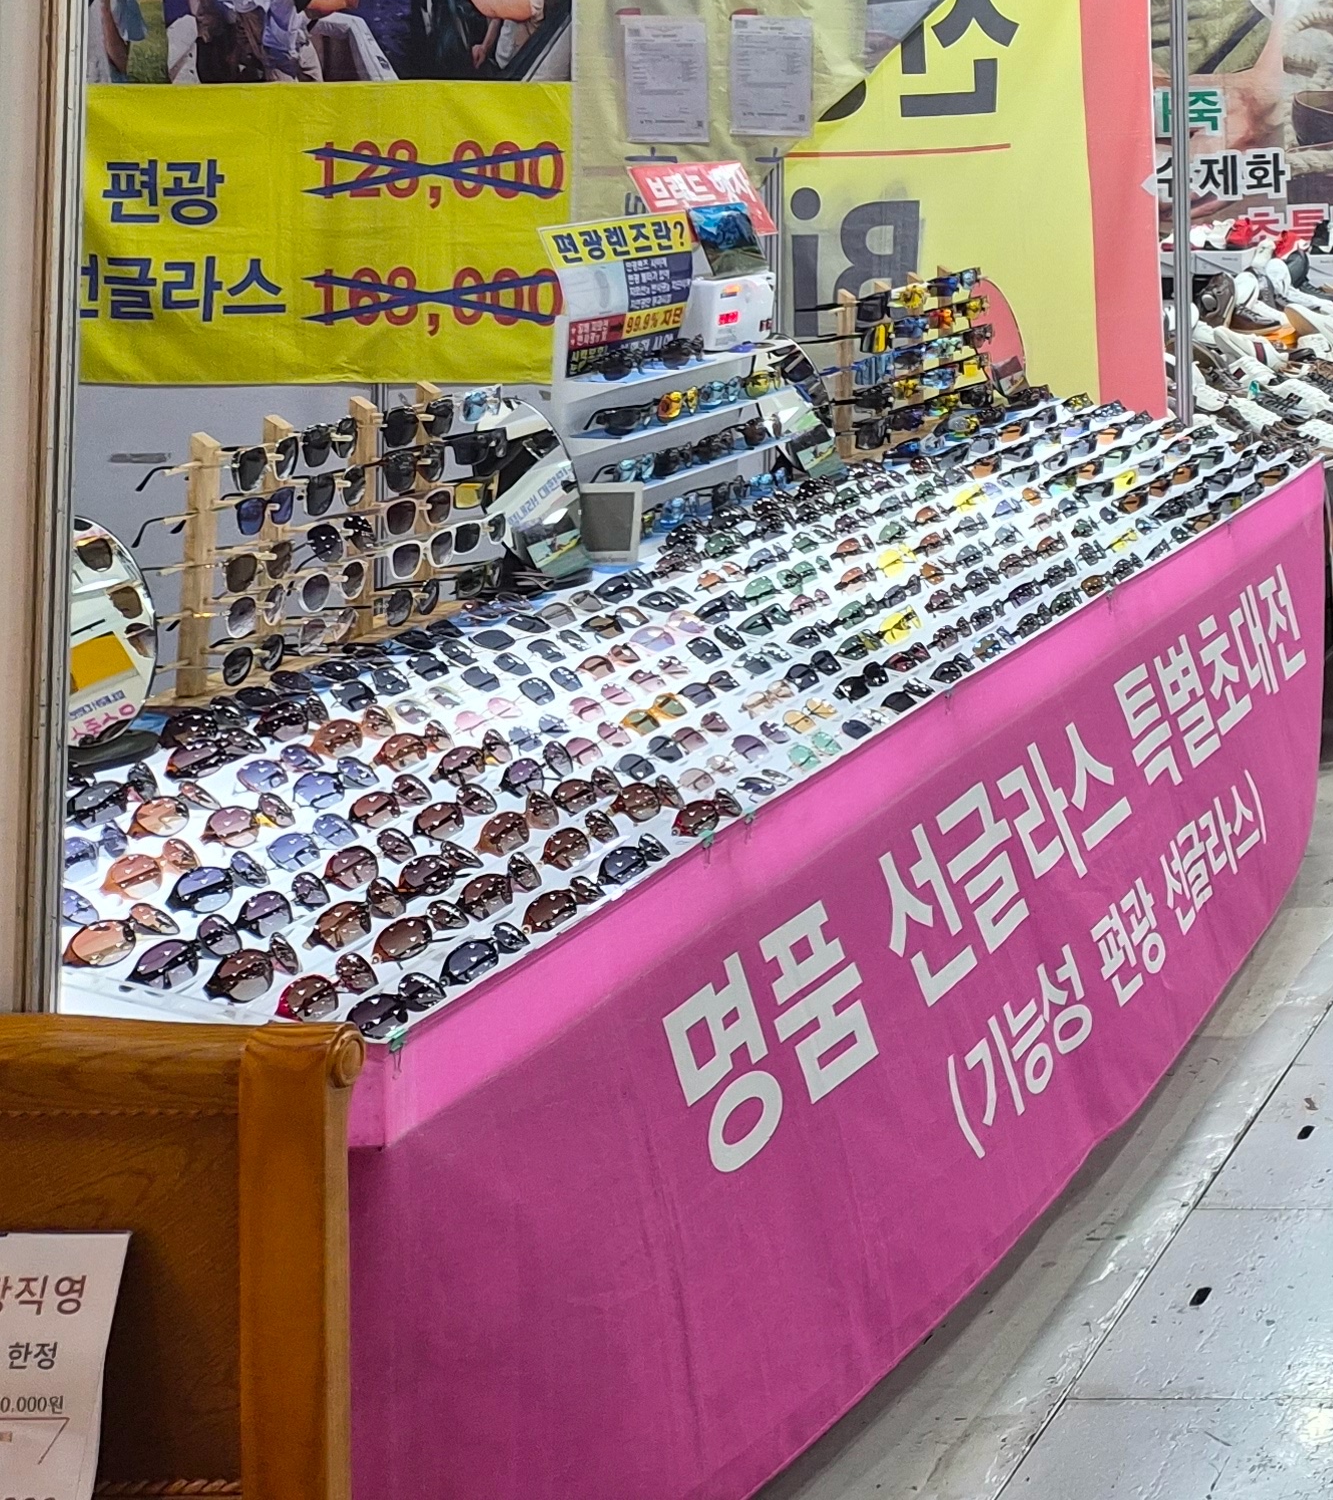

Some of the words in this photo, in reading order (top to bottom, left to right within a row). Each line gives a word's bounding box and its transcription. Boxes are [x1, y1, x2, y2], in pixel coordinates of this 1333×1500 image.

[103, 159, 224, 224] 편광
[314, 140, 563, 208] 128,000
[552, 220, 686, 264] 편광렌즈란?
[662, 901, 878, 1173] 명품
[878, 722, 1132, 1007] 선글라스
[1112, 564, 1306, 788] 특별초대전
[947, 944, 1095, 1159] (기능성
[1090, 878, 1167, 1007] 편광
[1158, 769, 1270, 937] 선글라스)
[8, 1342, 58, 1370] 한정
